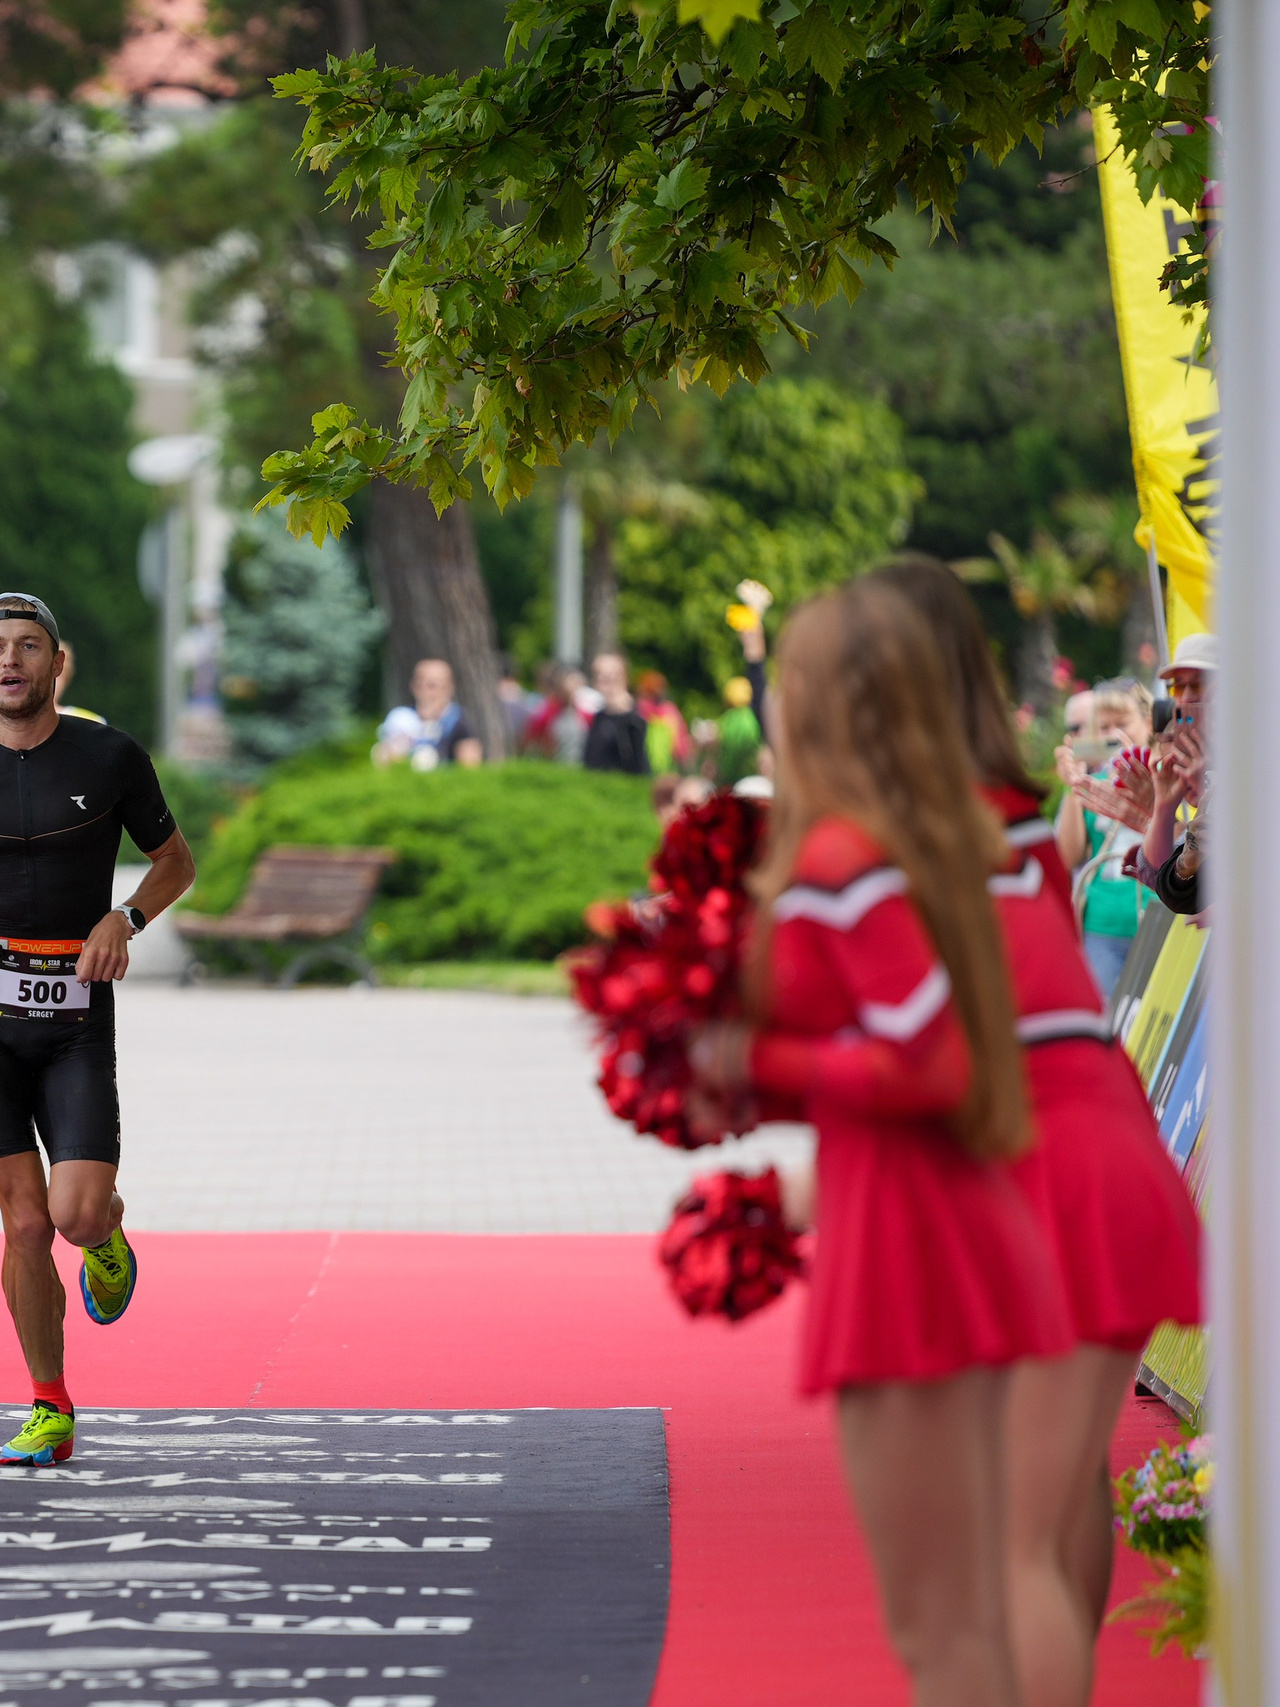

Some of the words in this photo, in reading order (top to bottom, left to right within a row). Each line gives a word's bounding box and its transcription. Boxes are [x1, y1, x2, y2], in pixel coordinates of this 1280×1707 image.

[9, 942, 81, 953] POWERUP
[18, 979, 67, 1005] 500
[28, 1010, 55, 1018] SERGEY
[266, 1415, 515, 1423] STAR
[238, 1472, 505, 1482] STAR
[203, 1533, 493, 1548] STAR
[154, 1611, 473, 1631] STAR
